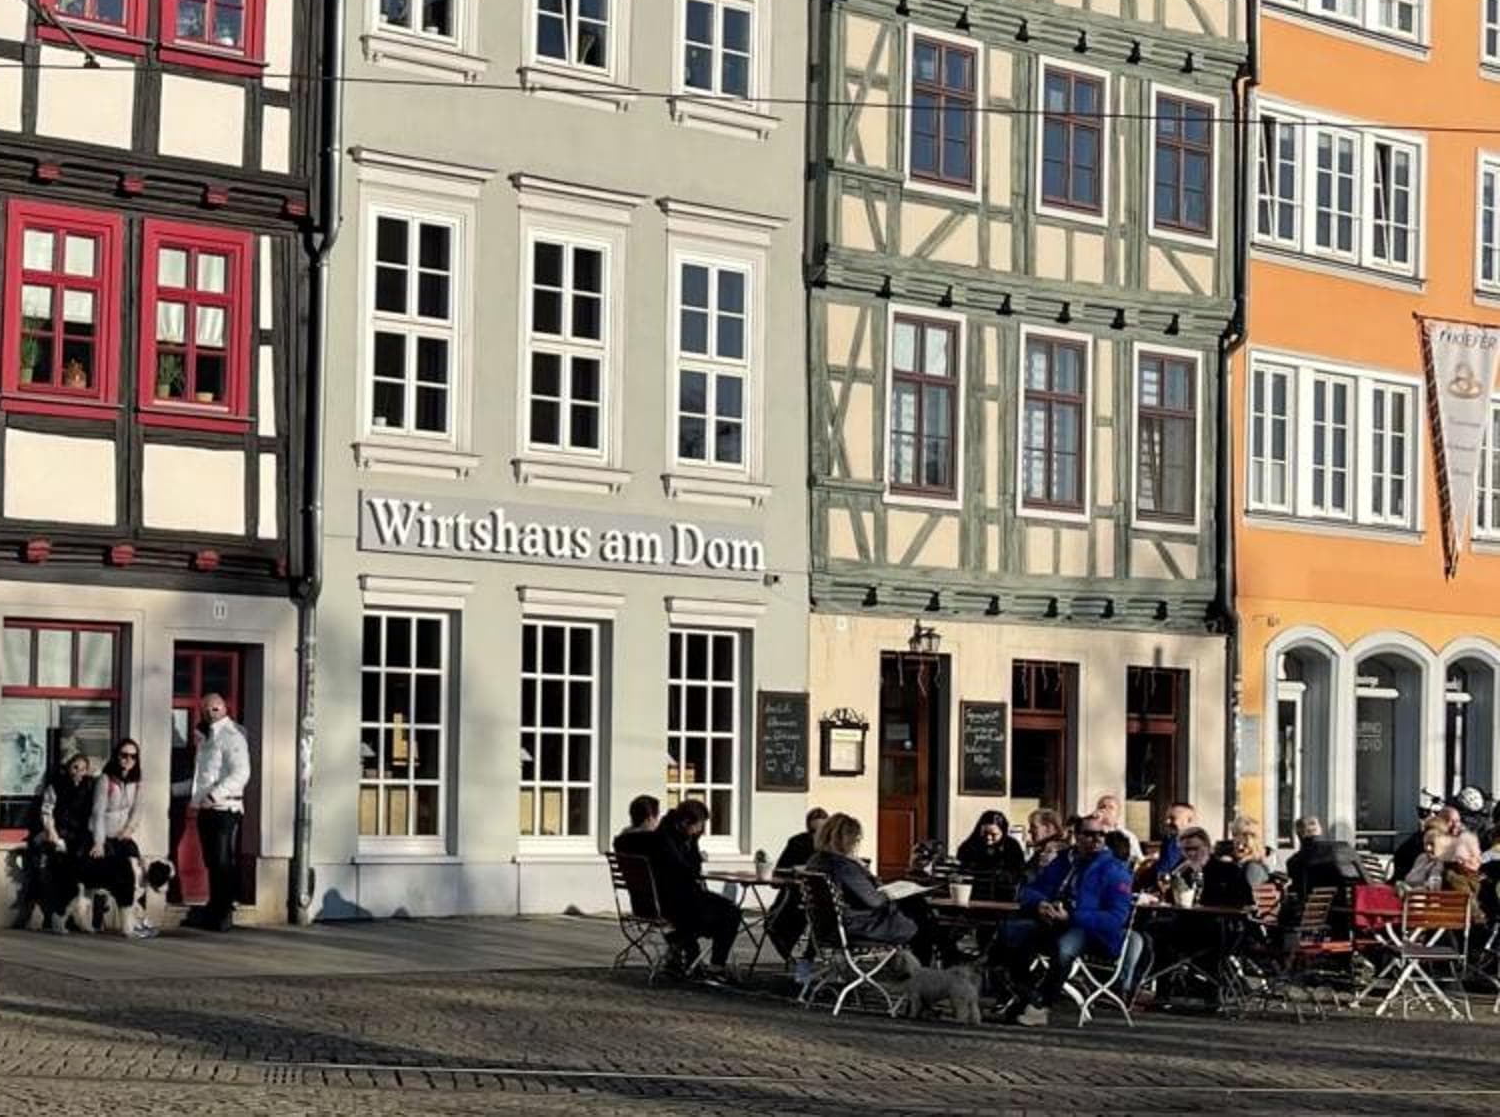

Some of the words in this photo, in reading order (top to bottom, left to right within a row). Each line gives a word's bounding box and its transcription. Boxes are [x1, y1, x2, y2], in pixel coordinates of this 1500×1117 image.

[367, 498, 592, 558] Wirtshaus
[601, 530, 664, 564] am
[670, 523, 766, 570] Dom
